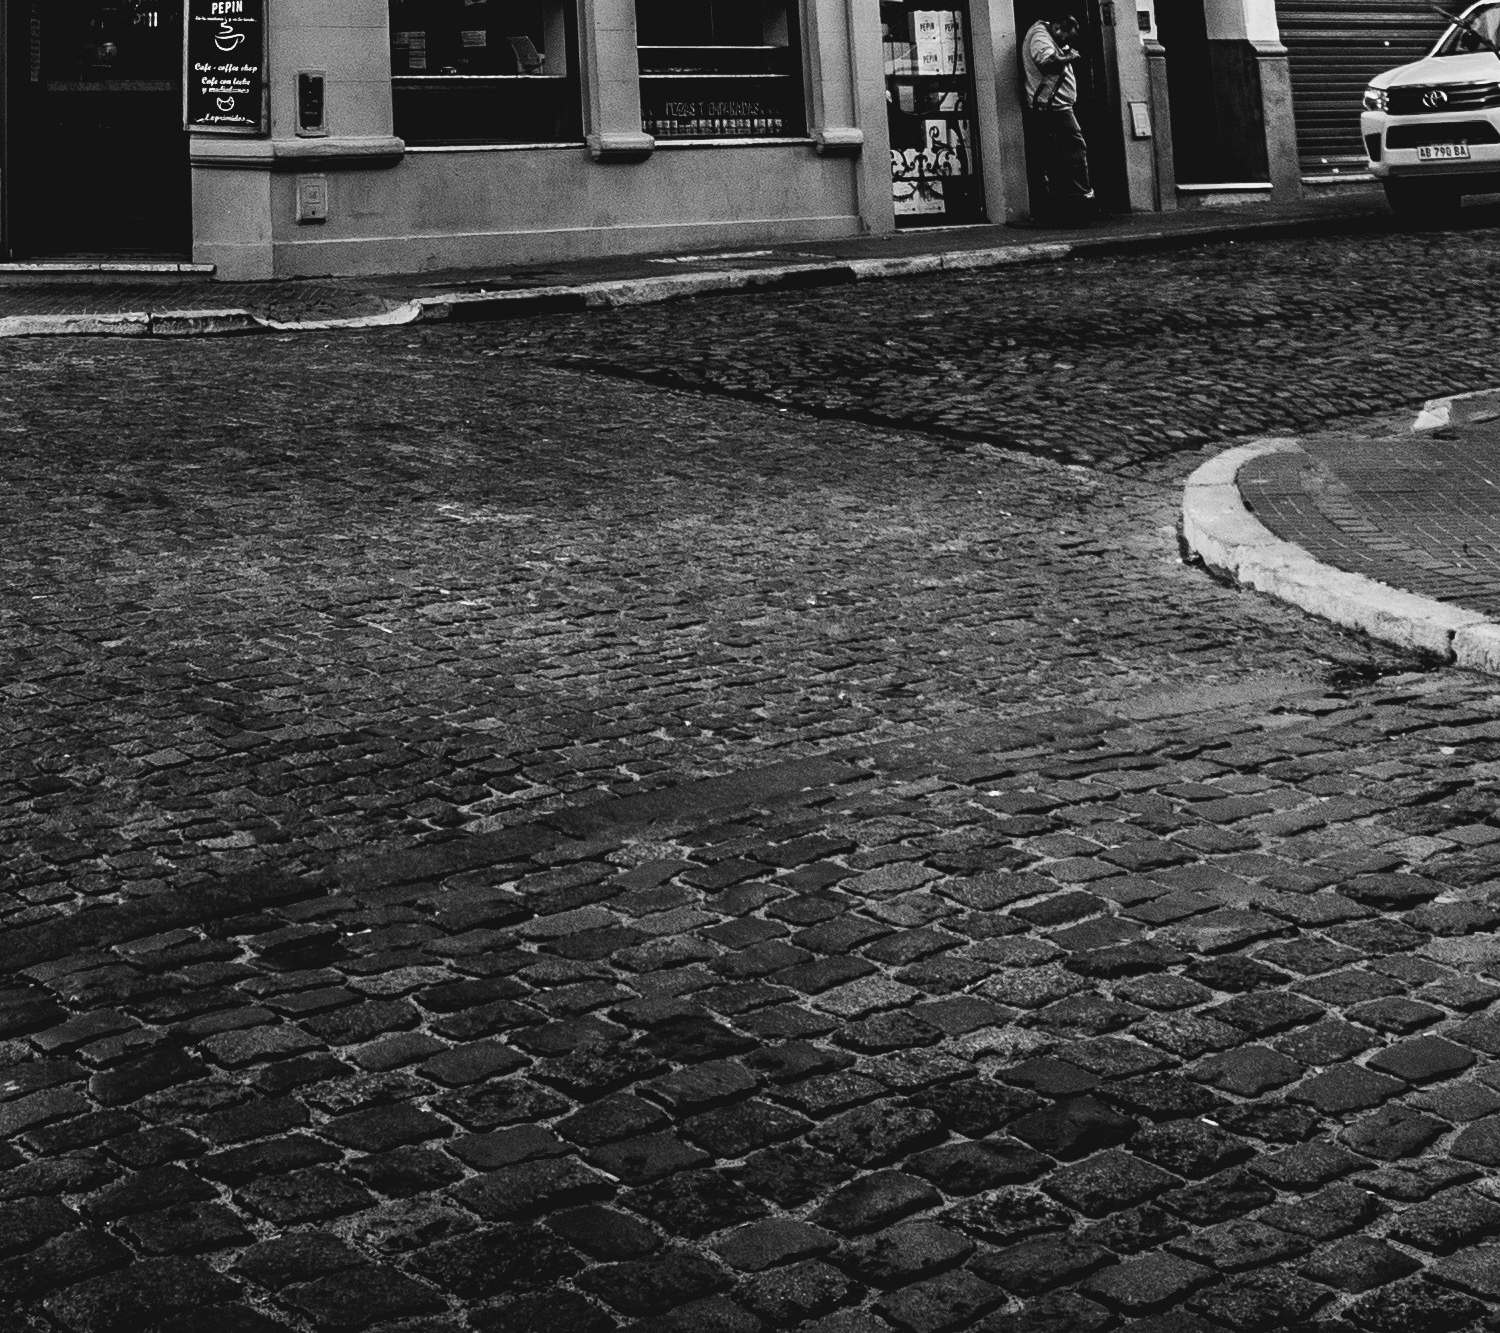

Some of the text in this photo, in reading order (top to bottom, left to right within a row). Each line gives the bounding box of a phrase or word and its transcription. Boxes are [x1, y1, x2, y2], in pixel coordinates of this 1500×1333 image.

[211, 0, 243, 15] PEPIN
[217, 63, 239, 73] coffee
[241, 64, 258, 74] shop
[233, 78, 251, 86] leche
[665, 101, 696, 117] PIZZAS
[1434, 147, 1452, 157] 790
